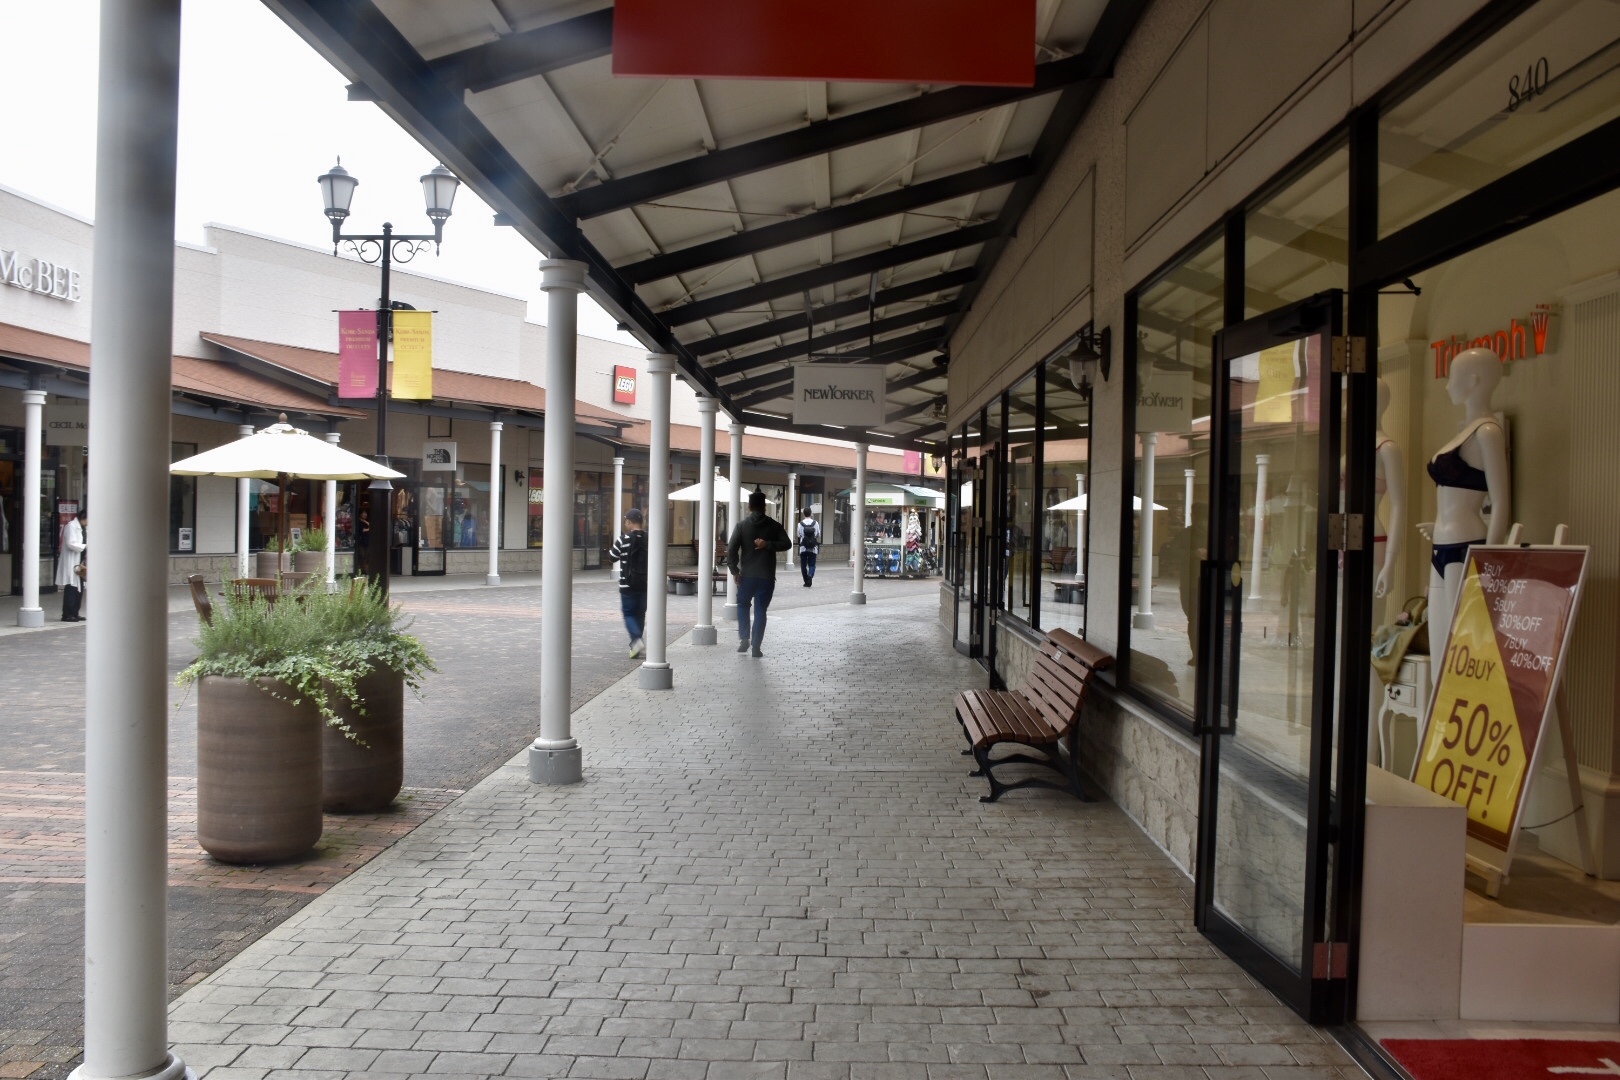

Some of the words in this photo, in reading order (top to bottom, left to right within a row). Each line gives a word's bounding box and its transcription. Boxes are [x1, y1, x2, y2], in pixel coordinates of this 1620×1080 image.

[1509, 57, 1548, 112] 840
[616, 376, 635, 393] LEGO
[49, 421, 72, 429] CECIL
[1481, 562, 1504, 577] 3BUY
[1493, 597, 1517, 613] 5BUY
[1504, 634, 1529, 651] 7BUY
[1448, 644, 1496, 682] 10BUY
[1443, 698, 1513, 767] 50%
[1431, 758, 1497, 819] OFF!
